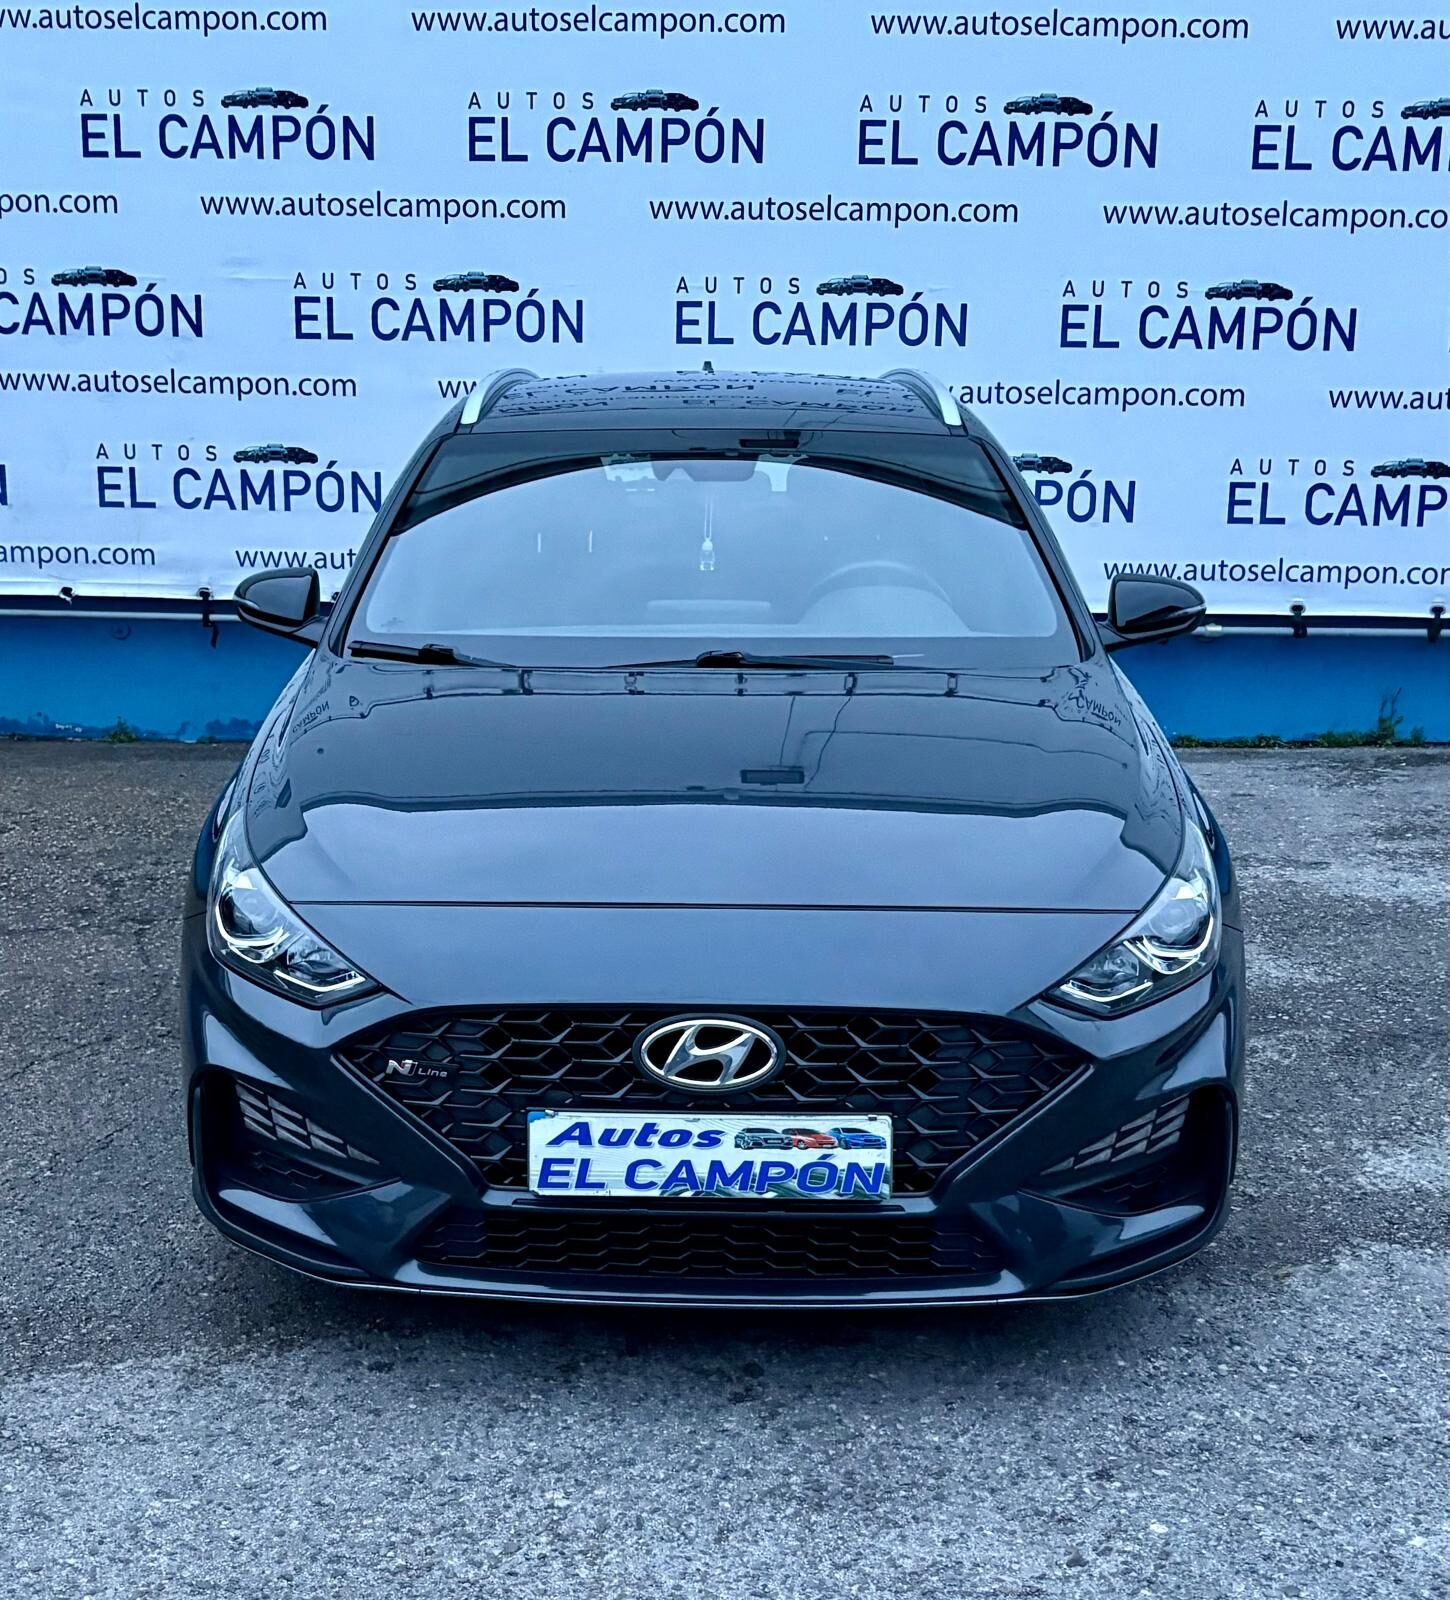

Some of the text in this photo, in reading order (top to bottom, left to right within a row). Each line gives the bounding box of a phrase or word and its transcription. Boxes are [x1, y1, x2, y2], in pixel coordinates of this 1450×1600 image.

[411, 4, 785, 40] www.autoselcampon.com
[870, 8, 1249, 45] www.autoselcampon.com
[79, 88, 205, 108] AUTOS
[467, 91, 594, 110] AUTOS
[859, 94, 987, 114] AUTOS
[1254, 99, 1384, 119] AUTOS
[80, 105, 375, 161] EL CAMPÓN
[468, 107, 765, 164] EL CAMPÓN
[858, 111, 1158, 169] EL CAMPÓN
[1251, 124, 1450, 172] EL CAM
[199, 190, 566, 225] www.autoselcampon.com
[649, 194, 1018, 229] www.autoselcampon.com
[1103, 199, 1449, 235] www.autoselcampon.co
[293, 271, 417, 291] AUTOS
[675, 276, 800, 295] AUTOS
[1062, 279, 1189, 299] AUTOS
[294, 287, 584, 344] EL CAMPÓN
[675, 291, 968, 347] EL CAMPÓN
[1059, 297, 1358, 352] EL CAMPÓN
[0, 367, 357, 402] www.autoselcampon.com
[949, 379, 1245, 412] autoselcampon.com
[95, 442, 217, 462] AUTOS
[1229, 458, 1355, 477] AUTOS
[96, 460, 382, 512] EL CAMPÓN
[1034, 469, 1136, 524] PÓN
[1226, 481, 1448, 528] EL CAMP
[235, 548, 357, 569] www.aut
[546, 1120, 724, 1148] Autos
[537, 1153, 887, 1195] EL CAMPÓN
